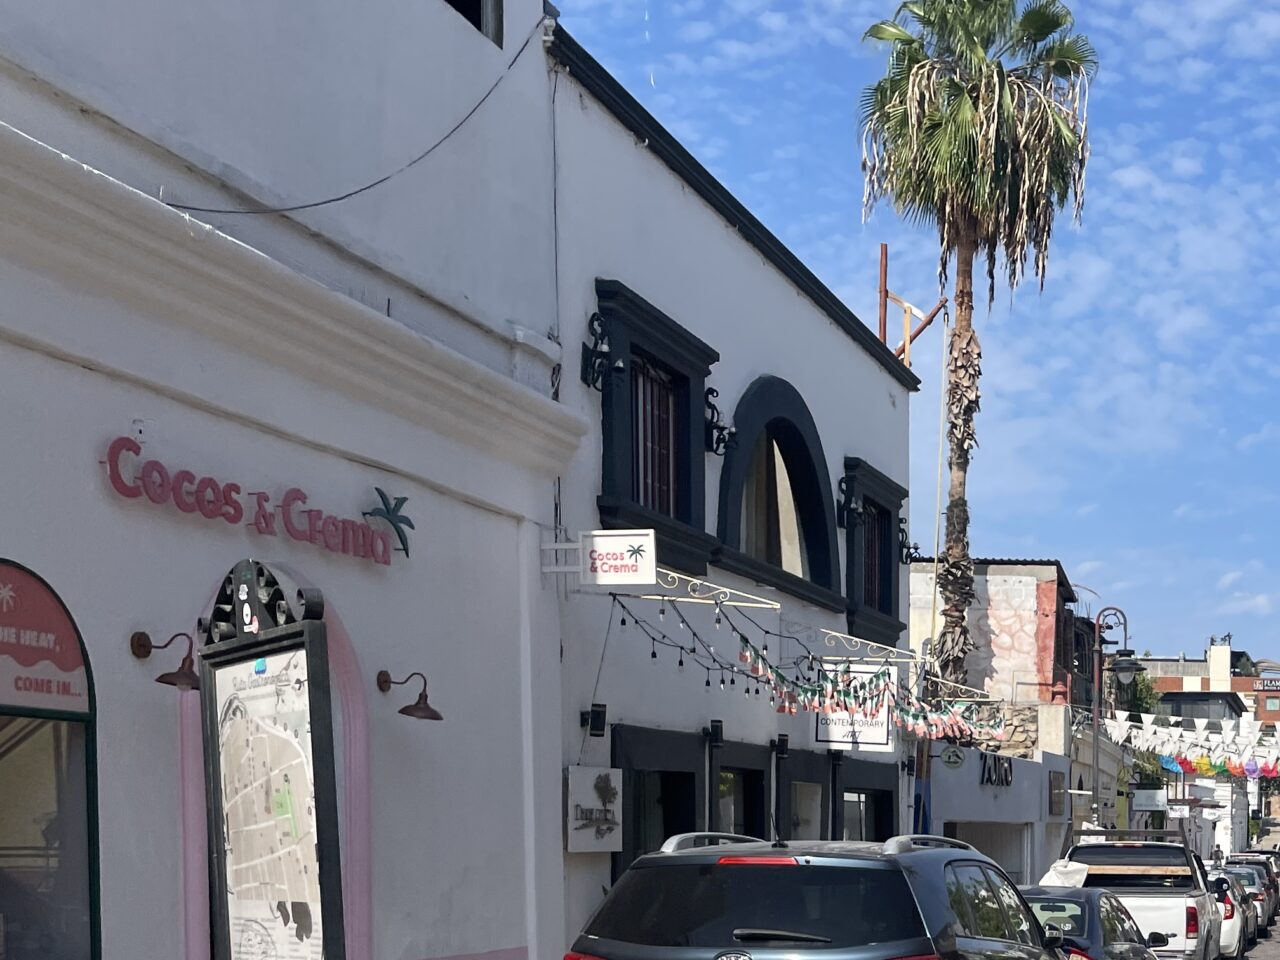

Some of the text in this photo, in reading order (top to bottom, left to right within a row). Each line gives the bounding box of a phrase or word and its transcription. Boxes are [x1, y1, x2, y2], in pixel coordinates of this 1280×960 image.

[106, 436, 391, 566] Cocos & Crema
[589, 549, 625, 561] Cocos
[600, 561, 639, 573] Crema
[14, 676, 53, 694] COME
[820, 717, 885, 728] CONTEMPORARY
